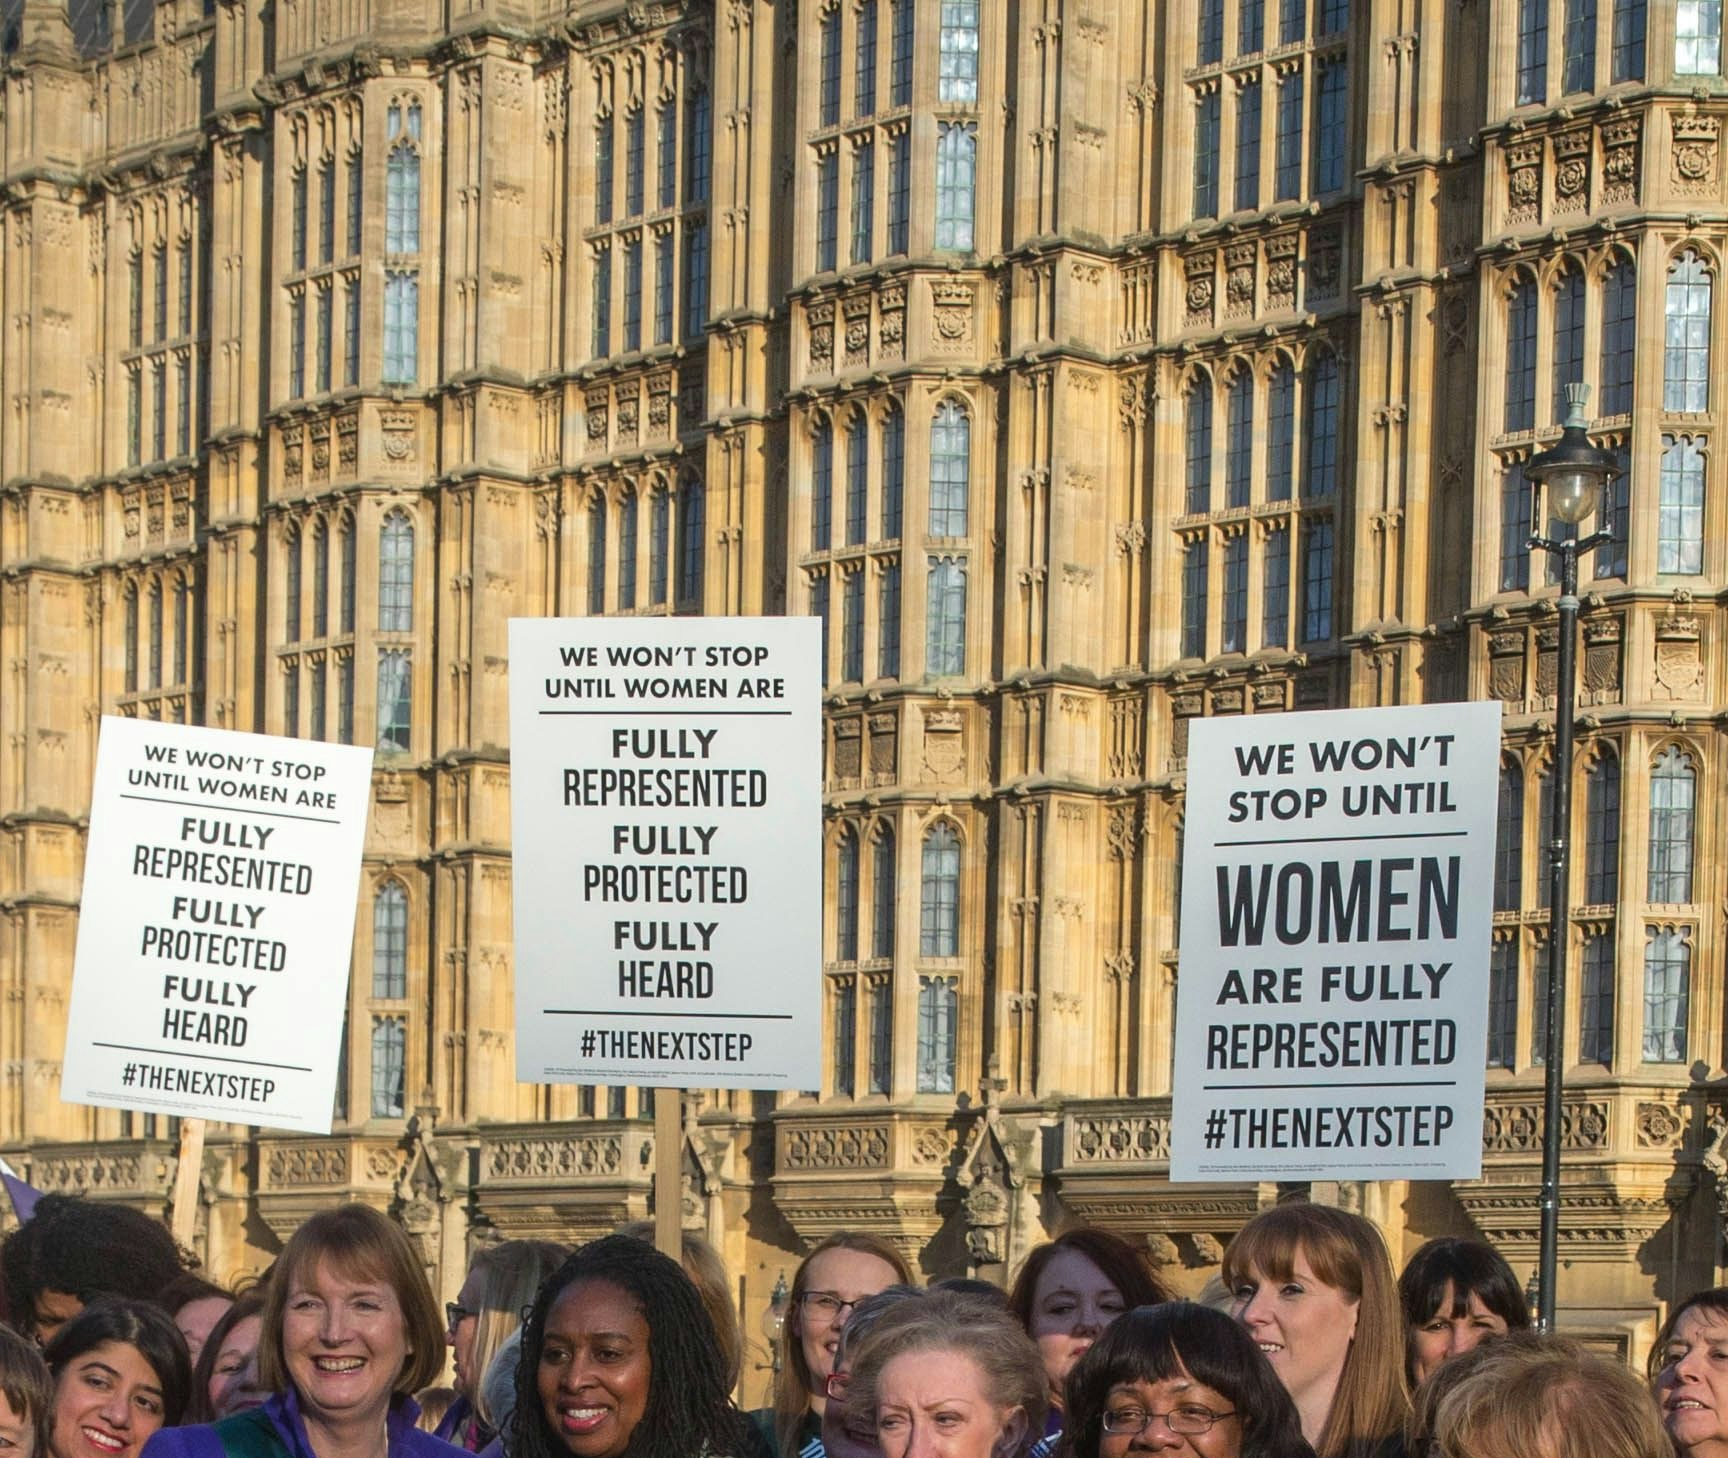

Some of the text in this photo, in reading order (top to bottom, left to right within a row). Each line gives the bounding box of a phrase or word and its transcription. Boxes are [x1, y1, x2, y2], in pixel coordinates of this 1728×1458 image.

[560, 647, 768, 666] WE WON'T STOP
[546, 679, 784, 698] UNTIL WOMEN ARE
[613, 729, 717, 758] FULLY
[1235, 735, 1454, 776] WE WON'T
[145, 745, 325, 781] WE WON'T STOP
[129, 769, 336, 809] UNTIL WOMEN ARE
[564, 769, 766, 807] REPRESENTED
[1228, 782, 1456, 822] STOP UNTIL
[182, 818, 274, 850] FULLY
[614, 826, 718, 855] FULLY
[133, 845, 312, 895] REPRESENTED
[585, 865, 747, 903] PROTECTED
[173, 897, 265, 929] FULLY
[1217, 856, 1460, 946] WOMEN
[142, 926, 286, 971] PROTECTED
[615, 921, 718, 951] FULLY
[164, 975, 256, 1008] FULLY
[619, 960, 713, 998] HEARD
[1216, 963, 1452, 1005] ARE FULLY
[163, 1008, 247, 1047] HEARD
[581, 1030, 752, 1061] #THENEXTSTEP
[1207, 1019, 1456, 1069] REPRESENTED
[123, 1063, 275, 1102] #THENEXTSTEP
[1205, 1106, 1453, 1148] #THENEXTSTEP
